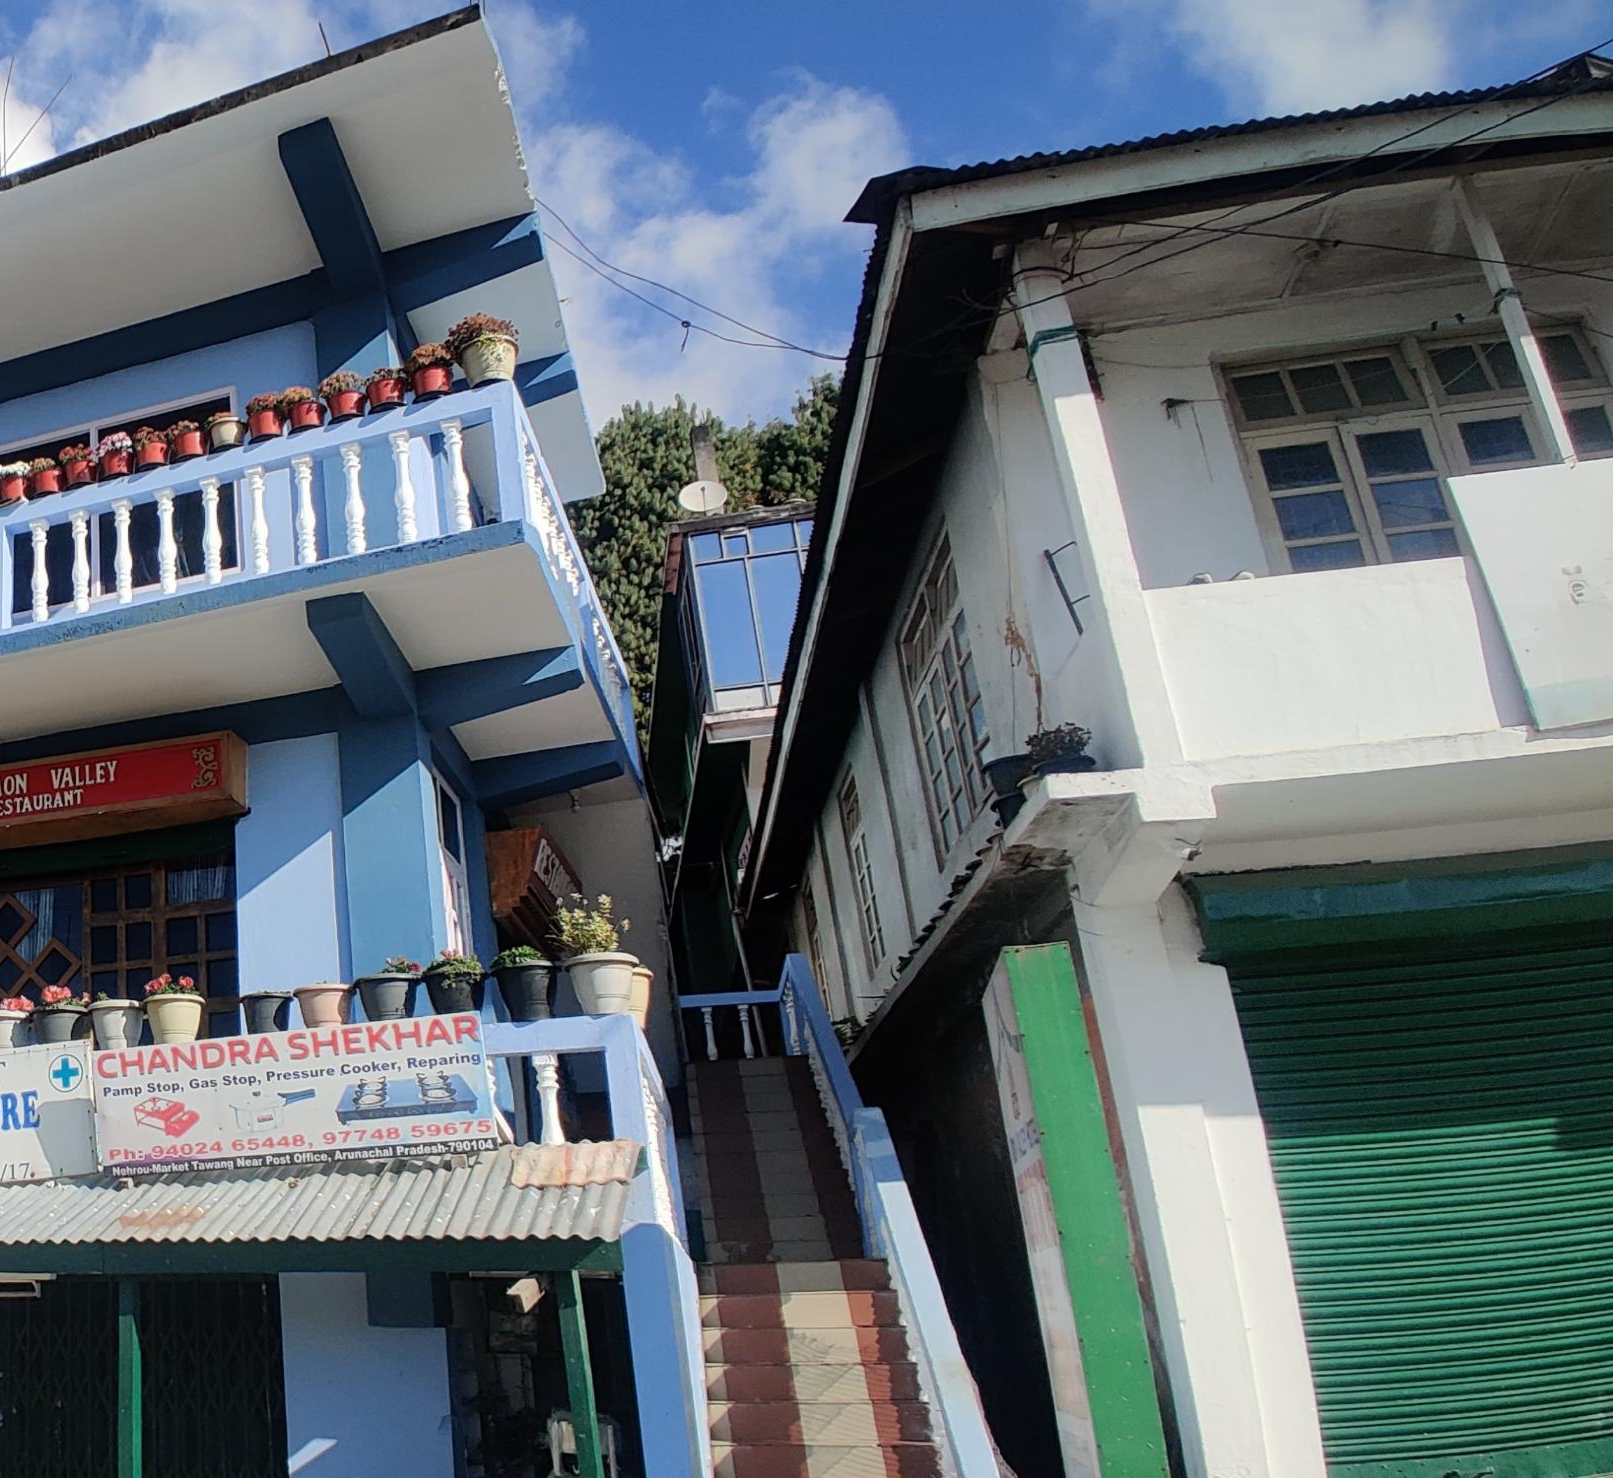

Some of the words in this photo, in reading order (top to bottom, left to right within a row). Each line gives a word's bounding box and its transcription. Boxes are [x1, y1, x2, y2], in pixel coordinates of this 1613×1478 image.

[50, 760, 118, 789] VALLEY
[97, 1036, 280, 1079] CHANDRA
[288, 1015, 481, 1060] SHEKHAR
[103, 1086, 143, 1098] Pamp
[147, 1081, 185, 1094] Stop,
[189, 1077, 218, 1089] Gas
[222, 1073, 262, 1087] Stop,
[266, 1064, 335, 1082] Pressure
[407, 1053, 481, 1070] Reparing
[109, 1149, 146, 1162] Ph:
[151, 1141, 224, 1159] 94024
[322, 1126, 402, 1145] 97748
[410, 1118, 493, 1138] 59675
[192, 1159, 235, 1171] Tawang
[236, 1157, 264, 1168] Near
[266, 1154, 291, 1165] Post
[334, 1145, 394, 1161] Arunachal
